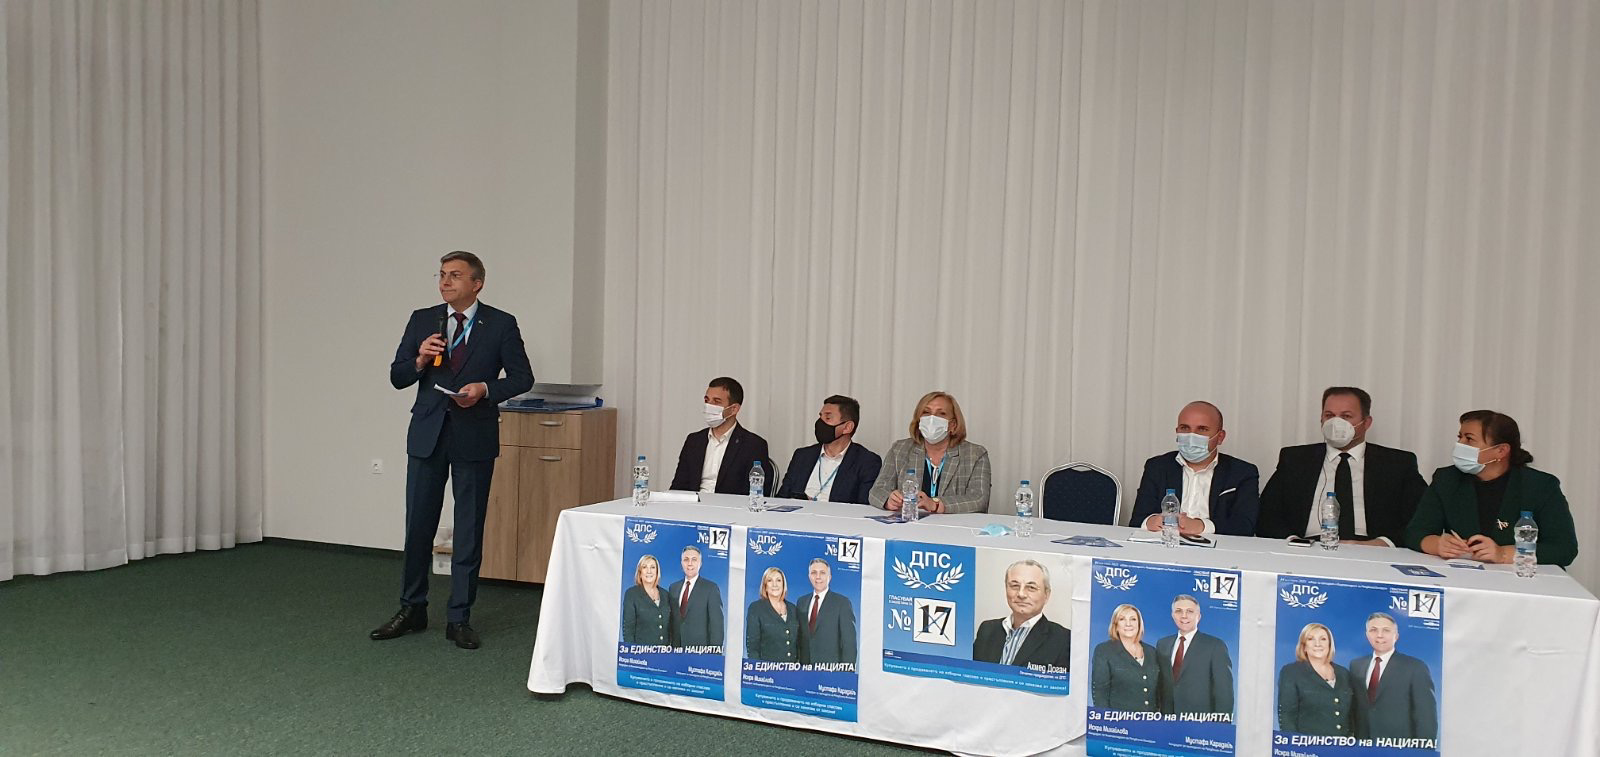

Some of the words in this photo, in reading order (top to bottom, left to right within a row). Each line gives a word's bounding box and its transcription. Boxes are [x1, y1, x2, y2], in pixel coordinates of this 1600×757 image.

[634, 524, 652, 532] ДПС
[712, 530, 727, 546] 17
[757, 535, 776, 544] ДПС
[842, 541, 858, 558] 17
[910, 550, 951, 569] ДПС
[1105, 567, 1130, 578] ДПС
[1193, 579, 1209, 592] №
[1214, 576, 1235, 594] 17
[1292, 584, 1319, 596] ДПС
[1389, 596, 1407, 610] №
[1412, 593, 1437, 613] 17
[888, 608, 911, 631] №
[918, 605, 952, 635] 17
[631, 645, 672, 654] ЕДИНСТВО
[685, 645, 724, 654] НАЦИЯТА!
[743, 662, 753, 670] За
[755, 662, 800, 672] ЕДИНСТВО
[814, 663, 856, 672] НАЦИЯТА!
[1027, 662, 1046, 674] Ахмед
[1047, 664, 1066, 674] Доган
[1089, 711, 1101, 720] За
[1104, 711, 1161, 722] ЕДИНСТВО
[1180, 713, 1234, 723] НАЦИЯТА!
[1275, 735, 1288, 744] За
[1292, 736, 1355, 746] ЕДИНСТВО
[1359, 738, 1372, 746] на
[1376, 738, 1437, 749] НАЦИЯТА!
